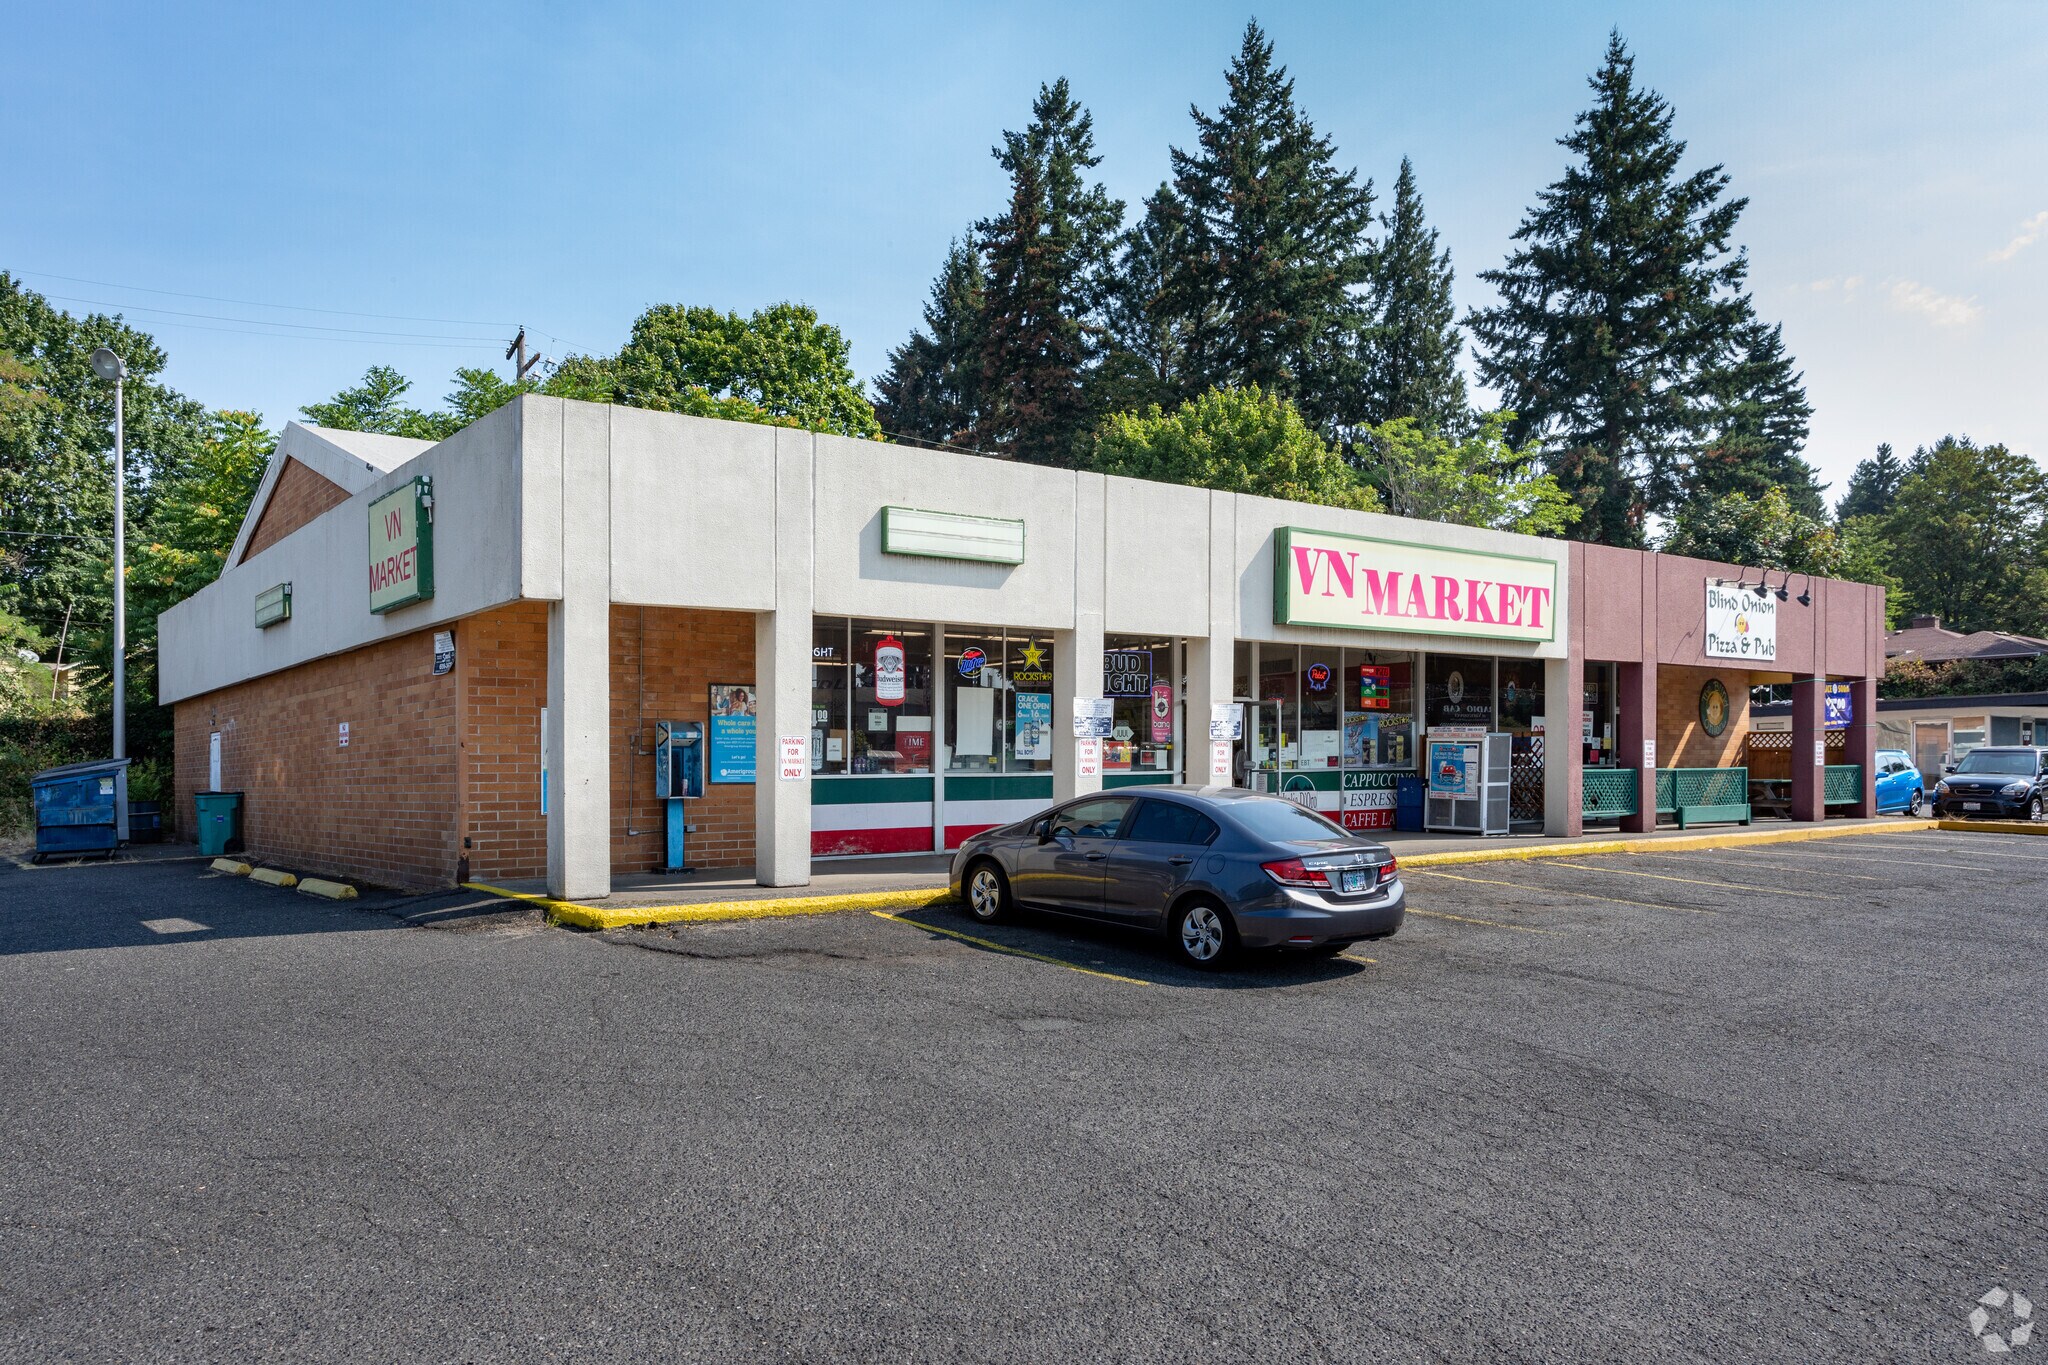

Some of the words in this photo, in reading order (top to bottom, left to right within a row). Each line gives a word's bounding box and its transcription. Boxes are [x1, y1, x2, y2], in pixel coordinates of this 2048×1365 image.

[384, 507, 402, 542] VN
[369, 545, 418, 593] MARKET
[1290, 545, 1360, 599] VN
[1361, 568, 1550, 629] MARKET
[1708, 589, 1739, 611] Blind
[1742, 594, 1775, 614] Onion
[811, 647, 834, 657] GHT
[1708, 633, 1738, 653] Pizza
[1741, 636, 1751, 654] &
[1754, 637, 1775, 656] Pub
[1103, 653, 1141, 673] BUD
[1103, 673, 1149, 693] IGHT
[1017, 695, 1039, 703] CRACK
[1032, 702, 1050, 710] OPEN
[1017, 710, 1023, 718] 6
[783, 768, 802, 777] ONLY
[1081, 766, 1096, 774] ONLY
[1350, 793, 1397, 807] ESPRESS
[1344, 812, 1378, 828] CAFFE
